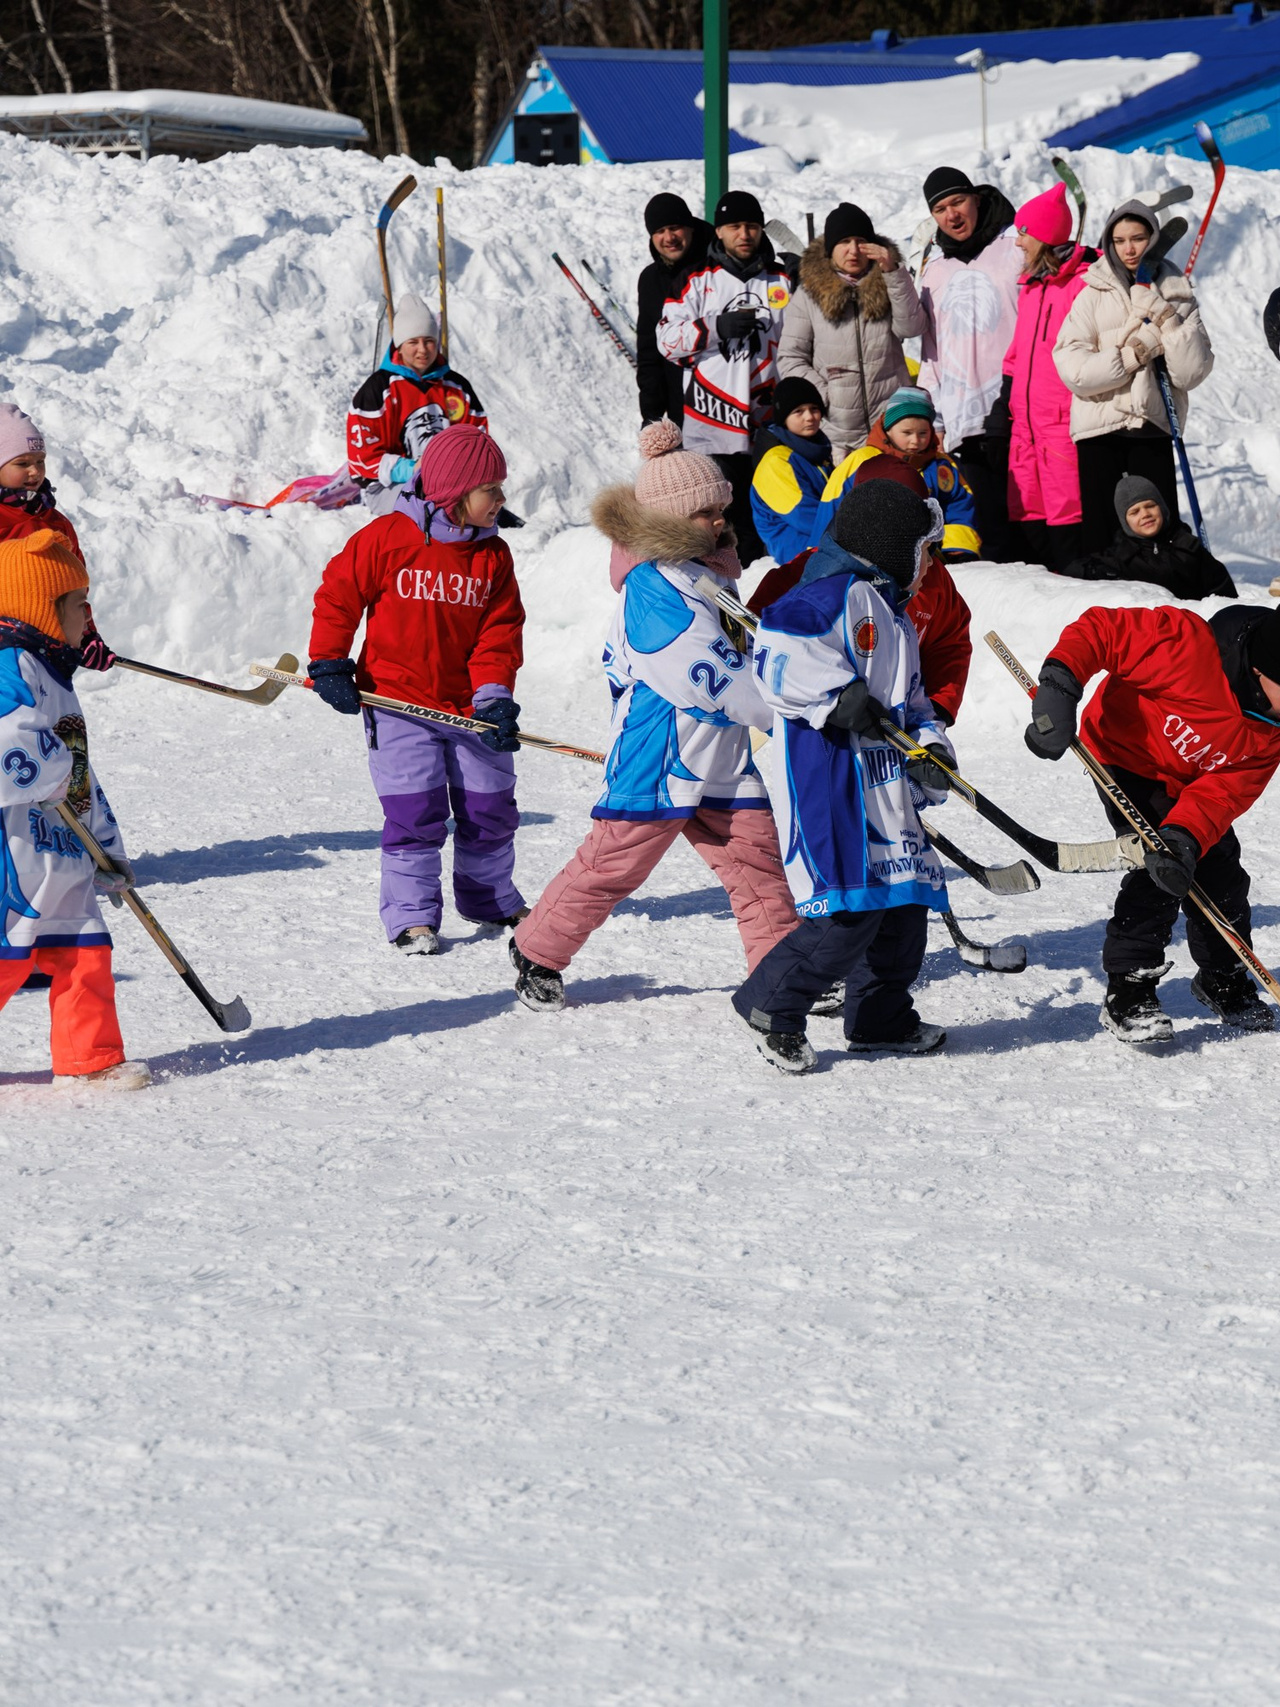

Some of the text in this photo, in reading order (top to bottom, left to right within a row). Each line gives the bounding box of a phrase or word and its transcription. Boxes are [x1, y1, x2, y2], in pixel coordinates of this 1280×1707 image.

[396, 568, 492, 607] СКАЗКА
[255, 667, 305, 686] TORNADO
[688, 635, 746, 701] 25
[753, 645, 790, 697] 11
[992, 639, 1034, 690] TORNADO
[402, 704, 479, 730] NORDWAY
[1, 729, 63, 788] 34
[1106, 784, 1170, 852] NORDWAY
[1239, 946, 1272, 986] TORNADO
